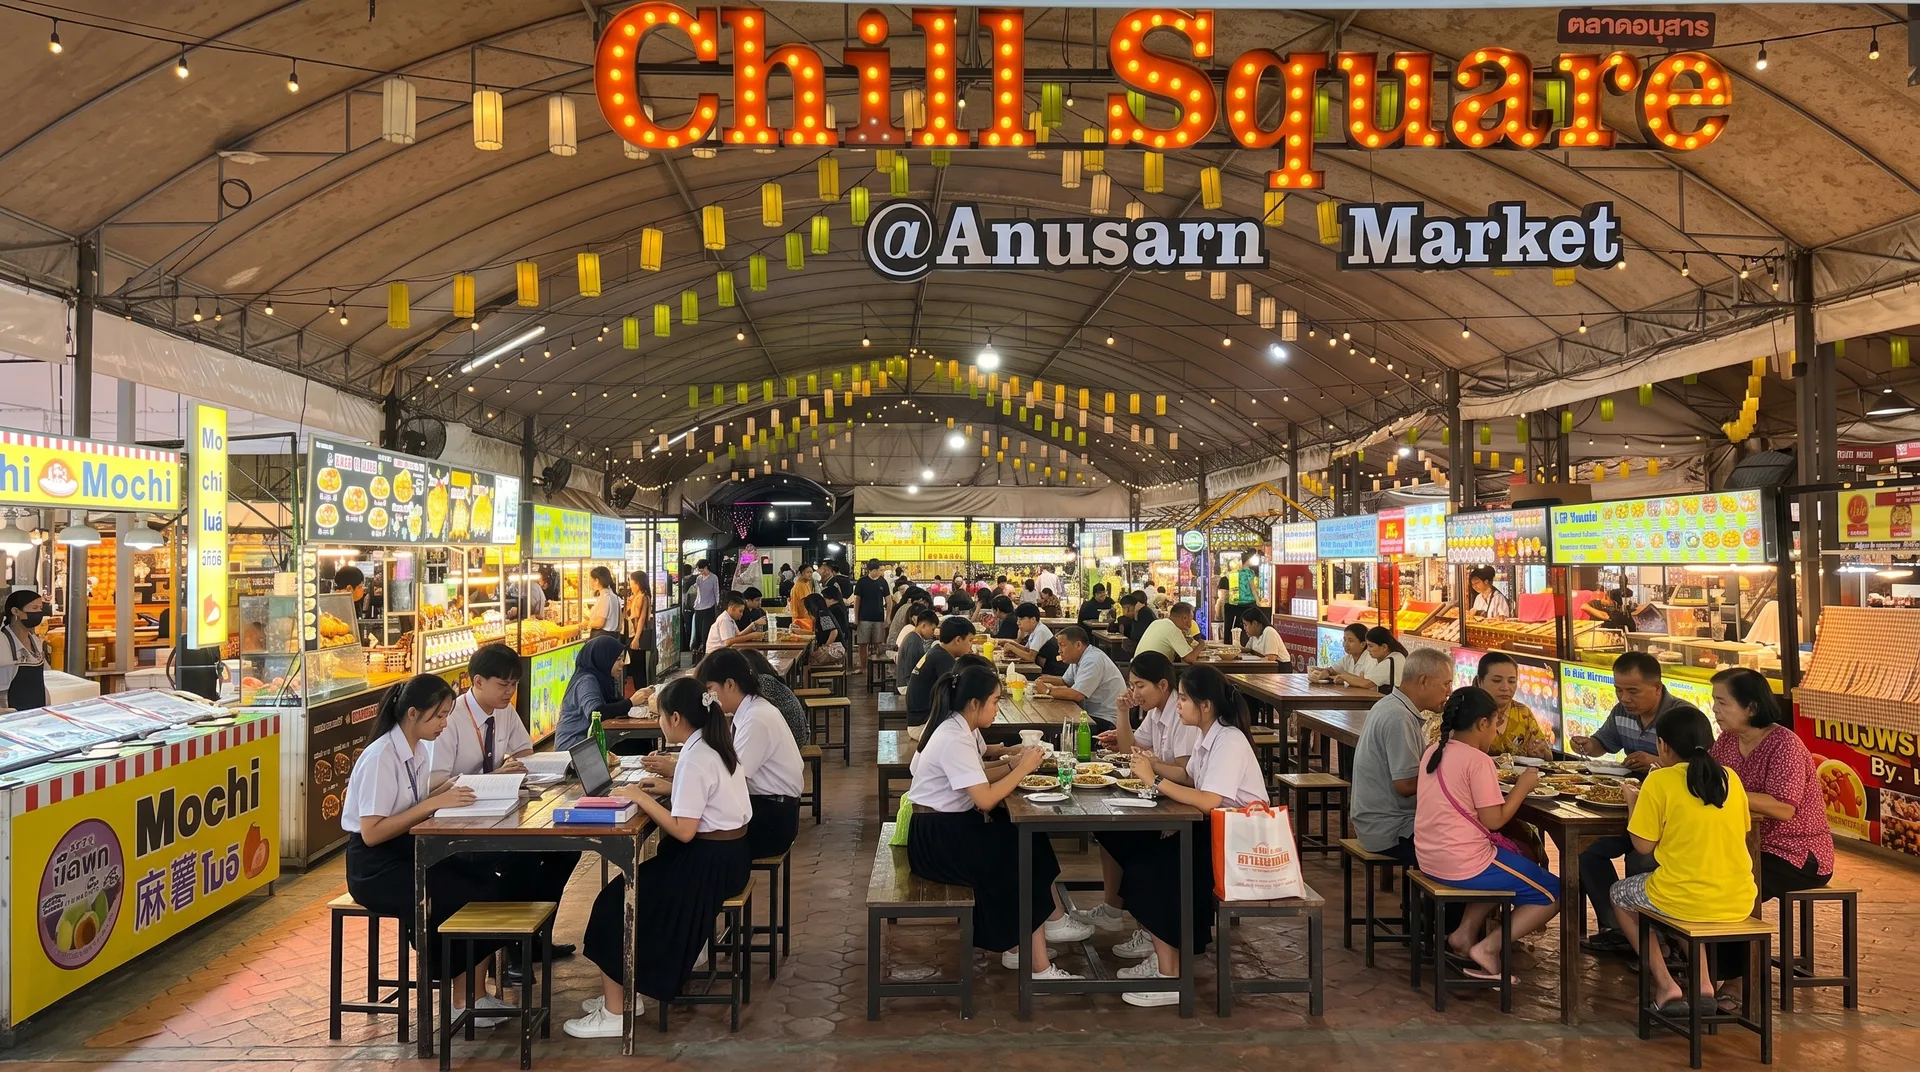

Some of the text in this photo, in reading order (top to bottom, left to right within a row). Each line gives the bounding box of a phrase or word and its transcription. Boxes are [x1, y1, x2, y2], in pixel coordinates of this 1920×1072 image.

[595, 2, 1733, 190] Chill Square
[867, 202, 1619, 279] @Anusarn Market
[202, 427, 223, 451] Mo
[82, 461, 171, 502] Mochi
[202, 470, 222, 492] chi
[136, 757, 260, 858] Mochi
